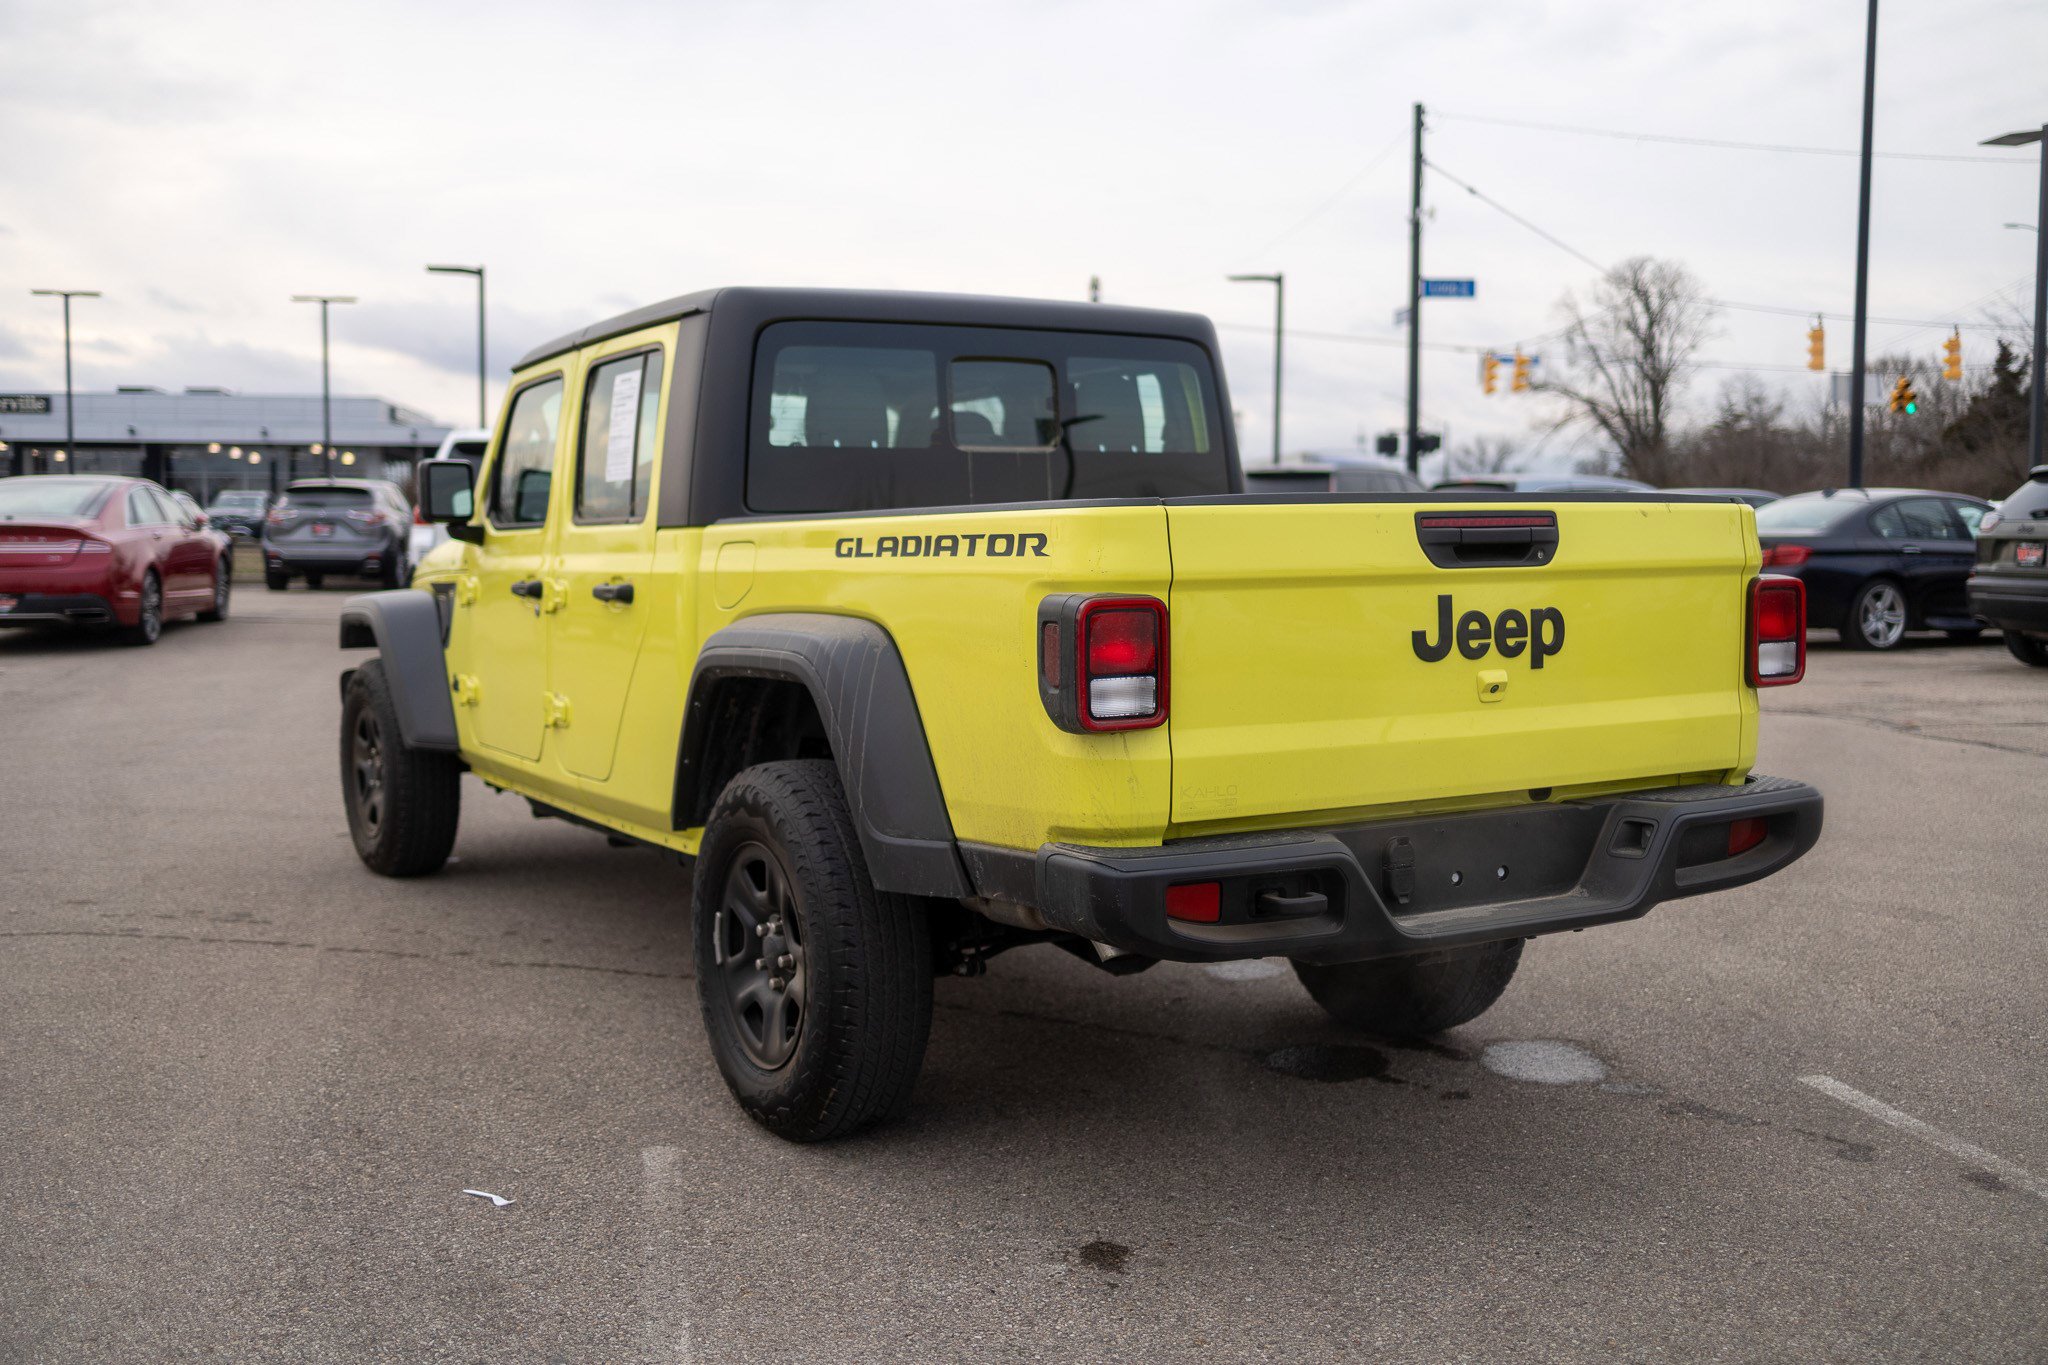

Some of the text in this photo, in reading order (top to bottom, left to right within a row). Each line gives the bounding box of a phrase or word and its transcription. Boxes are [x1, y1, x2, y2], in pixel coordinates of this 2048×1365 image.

[835, 532, 1050, 558] GLADIATOR
[1411, 594, 1566, 669] Jeep
[1180, 784, 1238, 800] KAHLO
